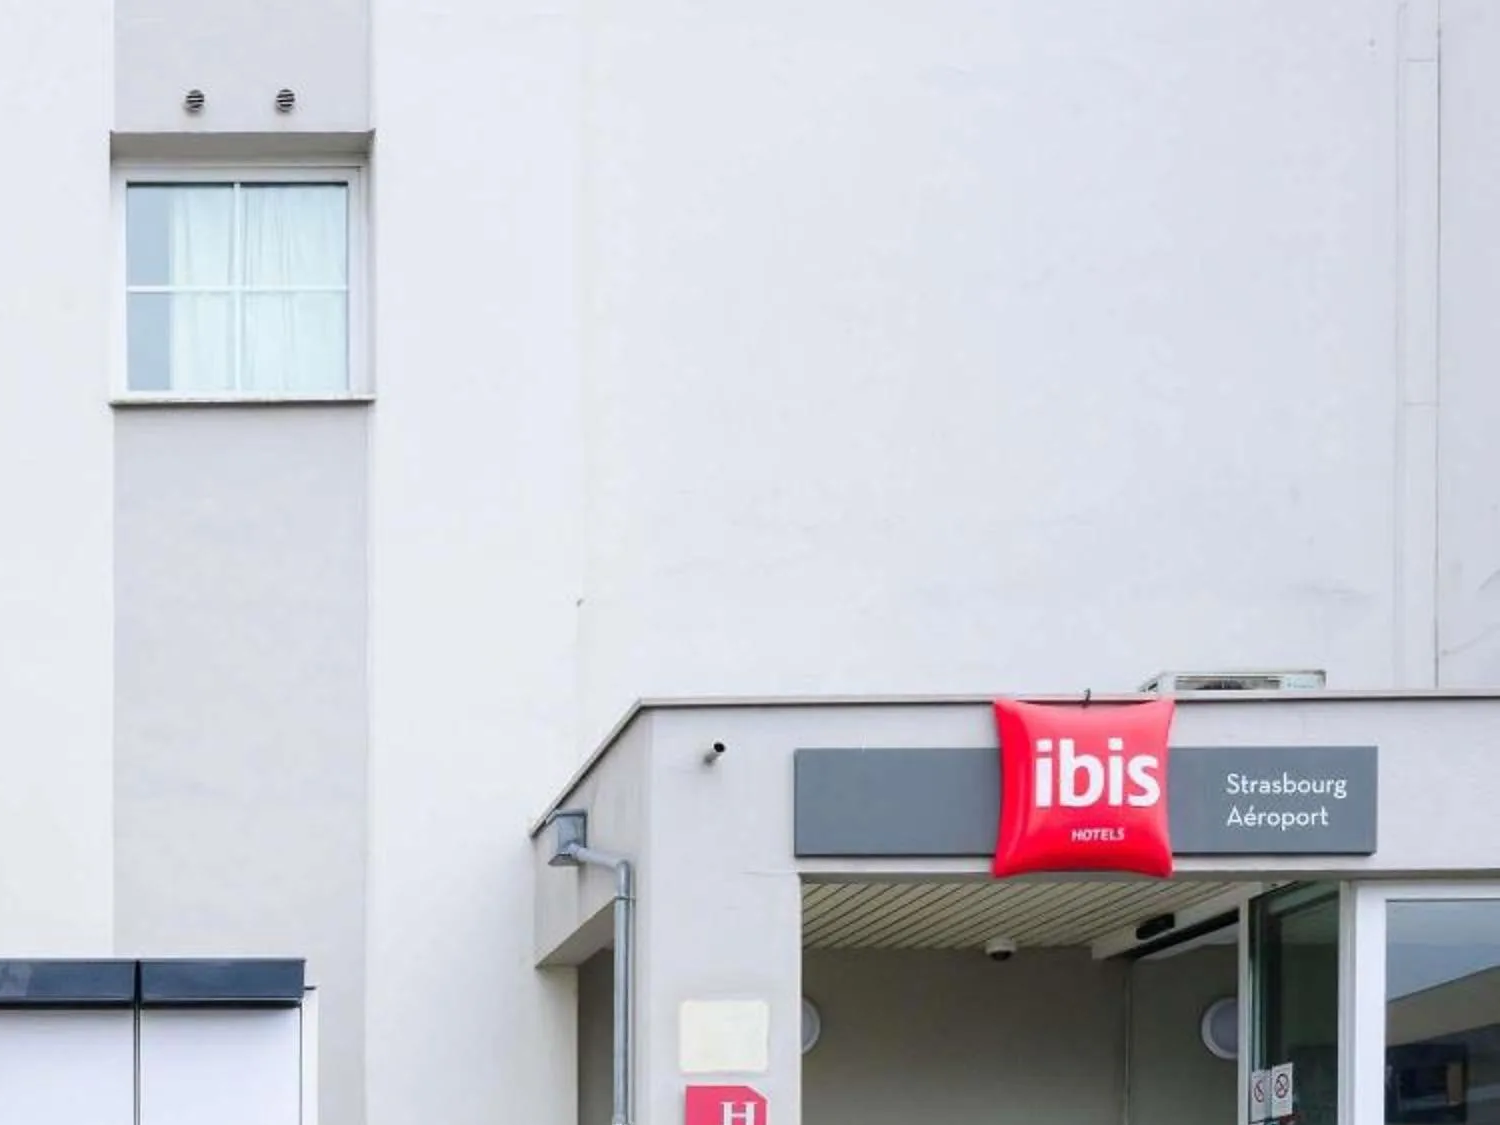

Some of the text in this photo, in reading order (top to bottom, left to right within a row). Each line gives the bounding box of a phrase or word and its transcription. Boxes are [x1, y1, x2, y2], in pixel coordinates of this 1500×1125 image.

[1035, 738, 1161, 806] ibis
[1225, 772, 1348, 799] Strasbourg
[1226, 805, 1330, 832] Aéroport
[1071, 828, 1125, 842] HOTELS
